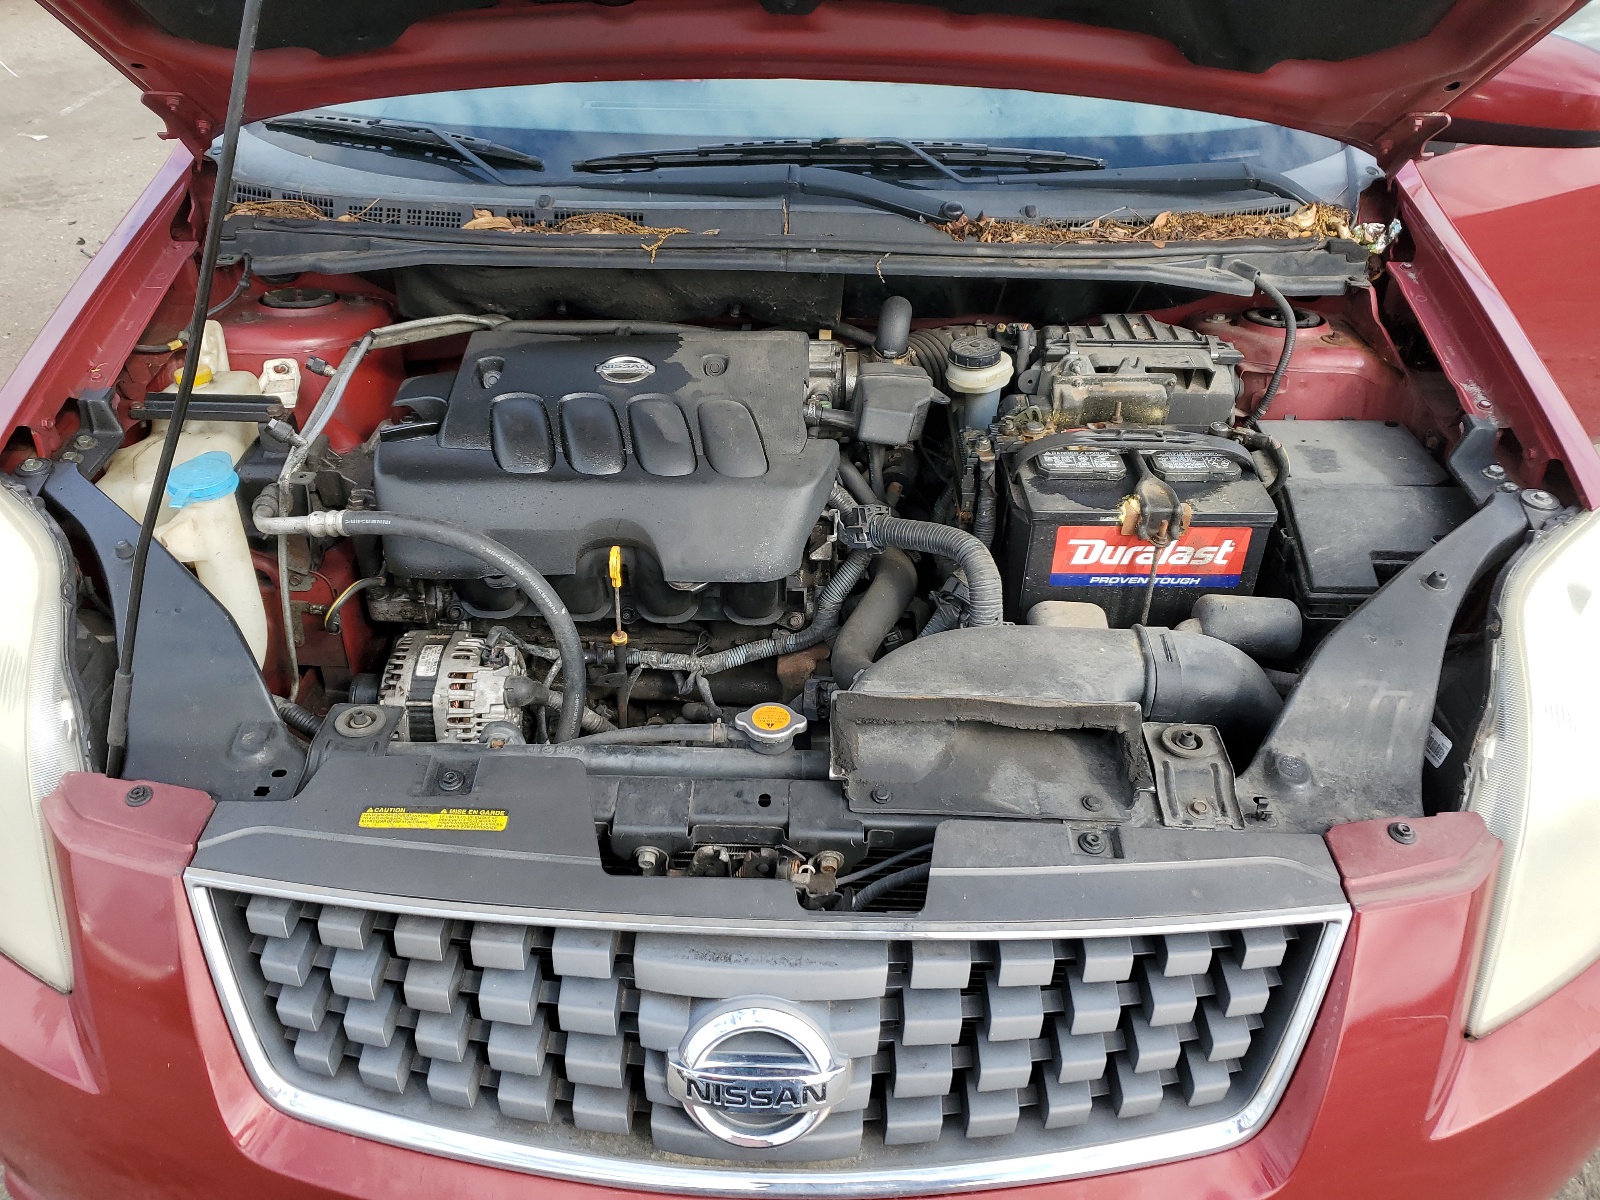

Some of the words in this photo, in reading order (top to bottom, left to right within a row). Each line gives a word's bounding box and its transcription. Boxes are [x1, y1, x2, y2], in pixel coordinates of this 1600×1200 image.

[1068, 539, 1233, 566] Duralast
[1089, 576, 1150, 585] PROVEN
[1154, 577, 1201, 585] TOUGH
[686, 1078, 827, 1109] NISSAN
